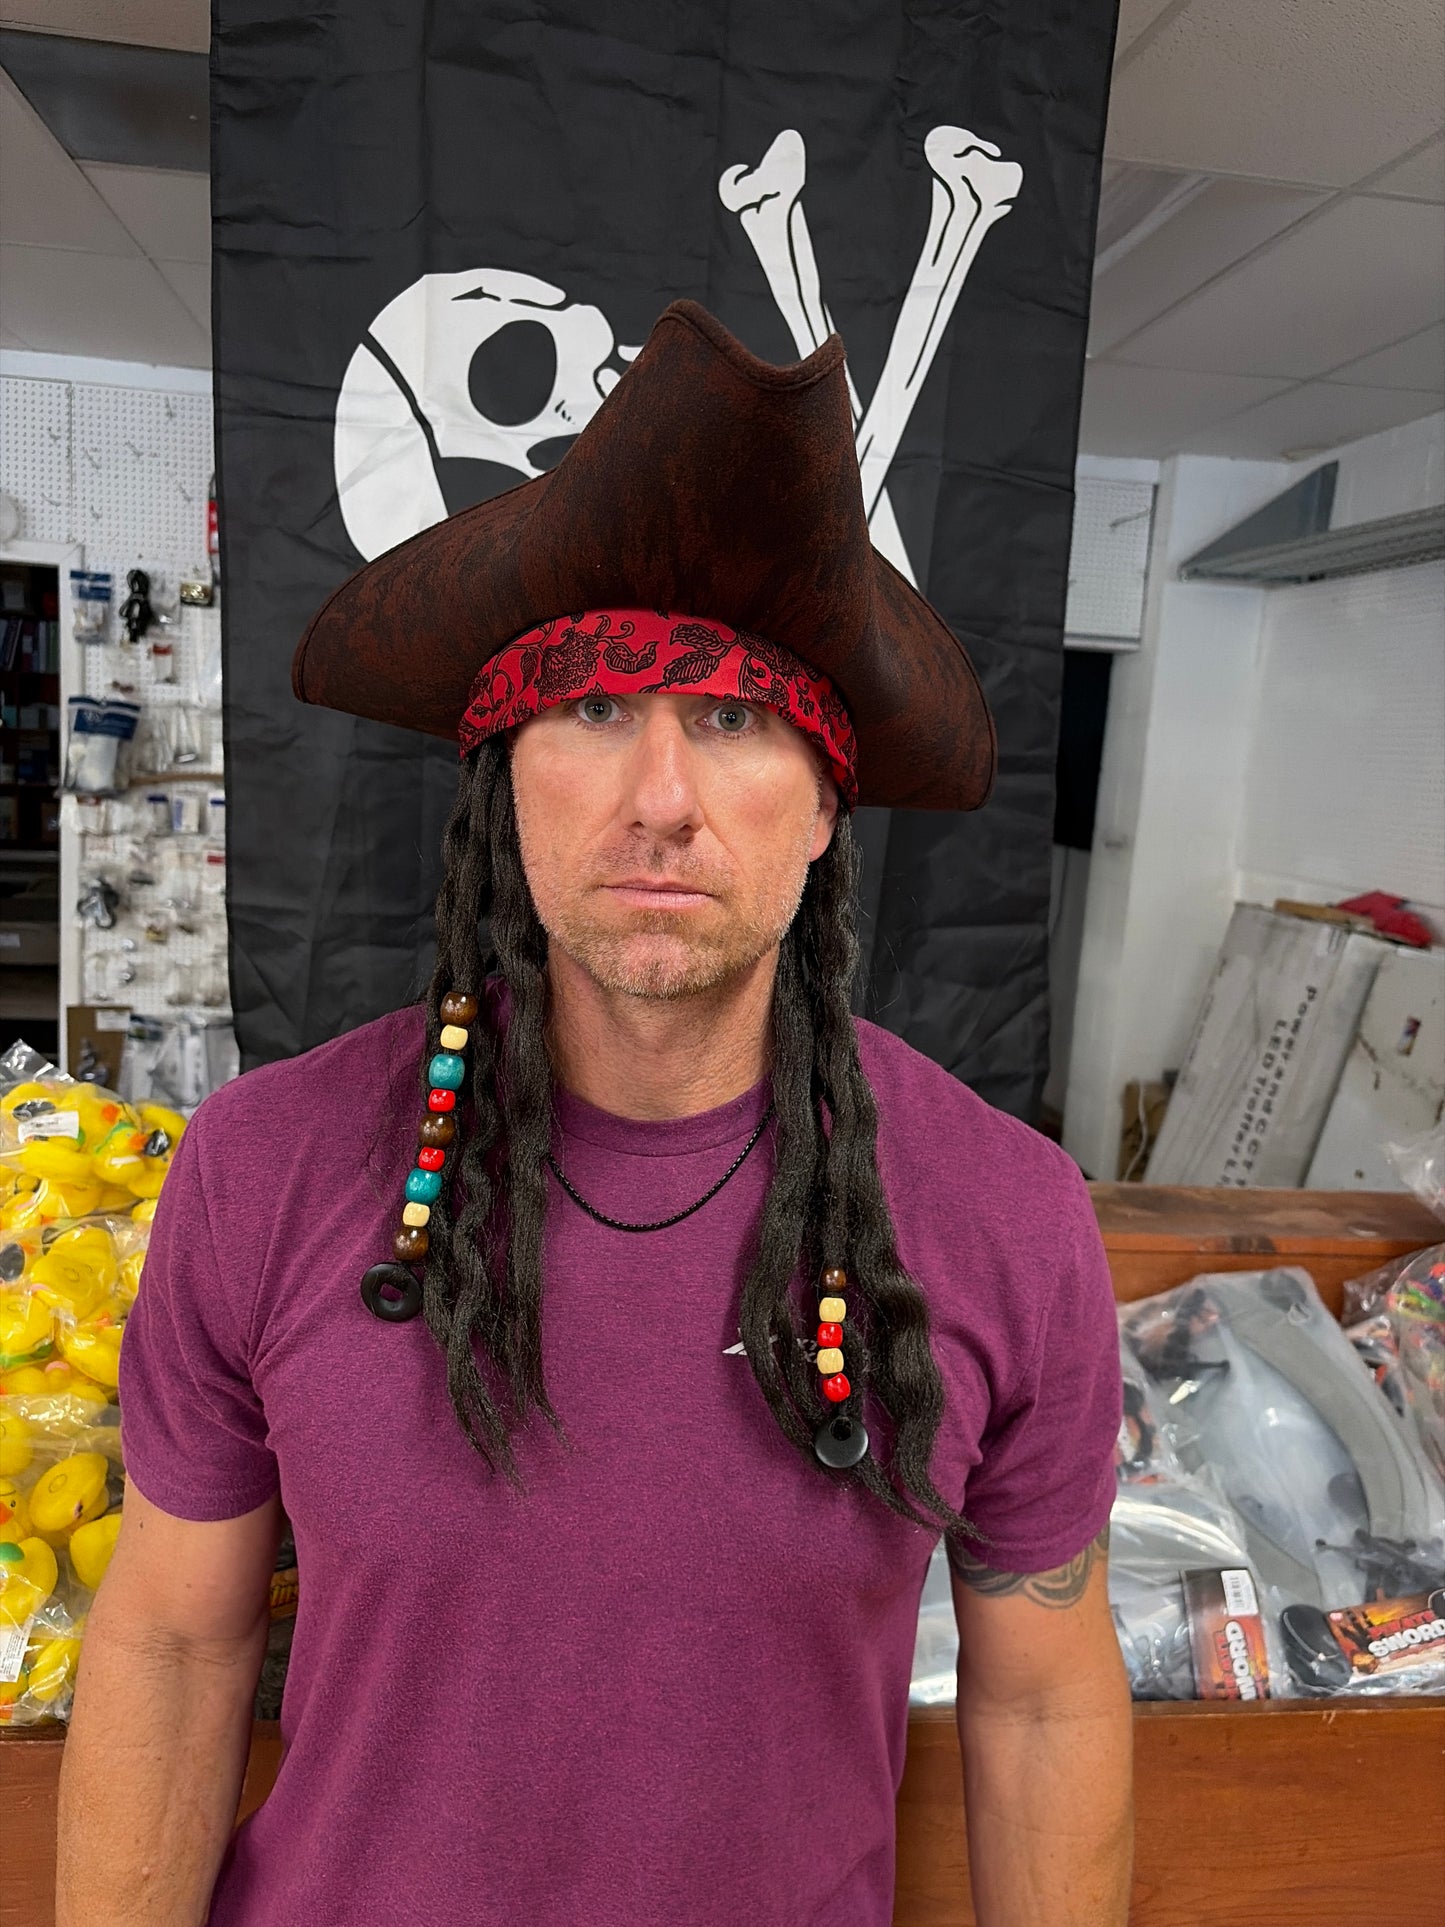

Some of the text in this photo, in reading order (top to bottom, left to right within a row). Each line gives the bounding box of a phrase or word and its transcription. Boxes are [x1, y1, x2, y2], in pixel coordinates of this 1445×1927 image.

[1231, 1019, 1287, 1155] LED Troffer
[1242, 985, 1317, 1170] Power and CCT
[1225, 1620, 1257, 1701] WORD
[1368, 1618, 1445, 1657] SWORD
